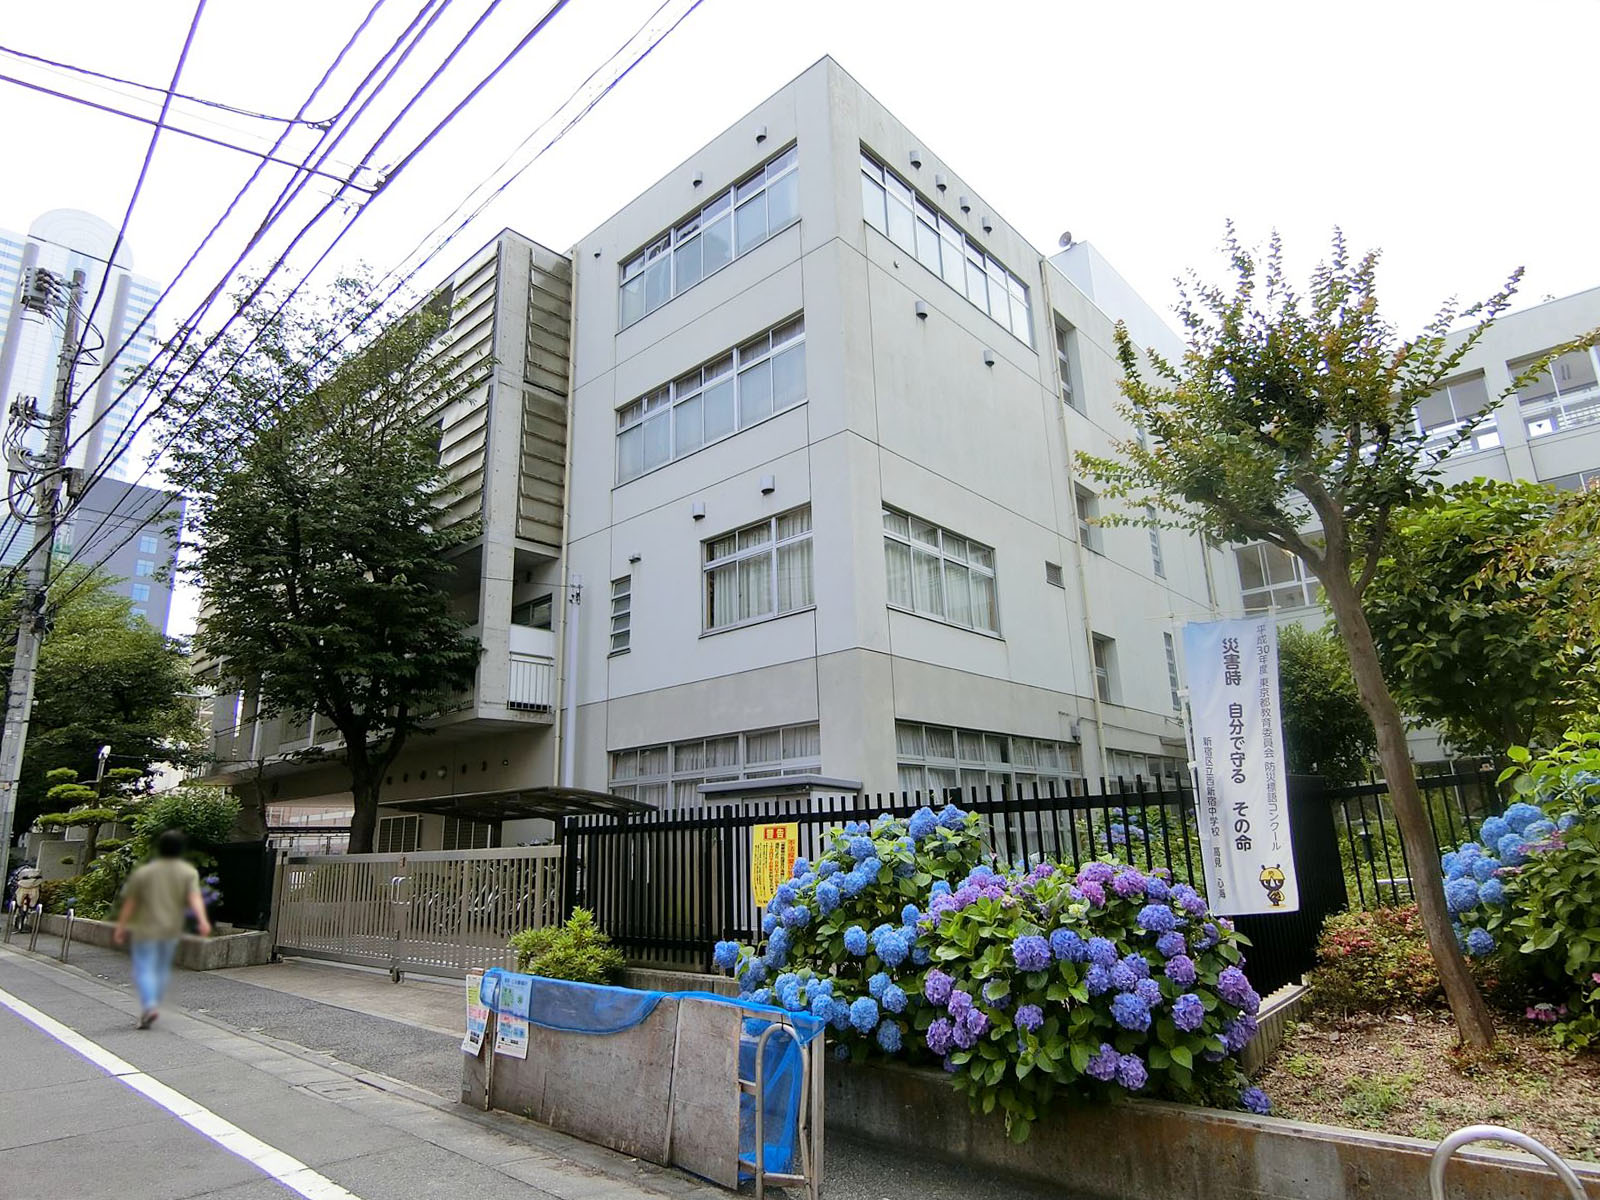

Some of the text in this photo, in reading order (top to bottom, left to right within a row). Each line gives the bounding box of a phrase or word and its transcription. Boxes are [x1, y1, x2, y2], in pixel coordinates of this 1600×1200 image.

[1256, 624, 1270, 675] 平成30年度
[1202, 736, 1220, 837] 新宿区立西新宿中学校
[1222, 637, 1252, 852] 災害時 自分で守る その命
